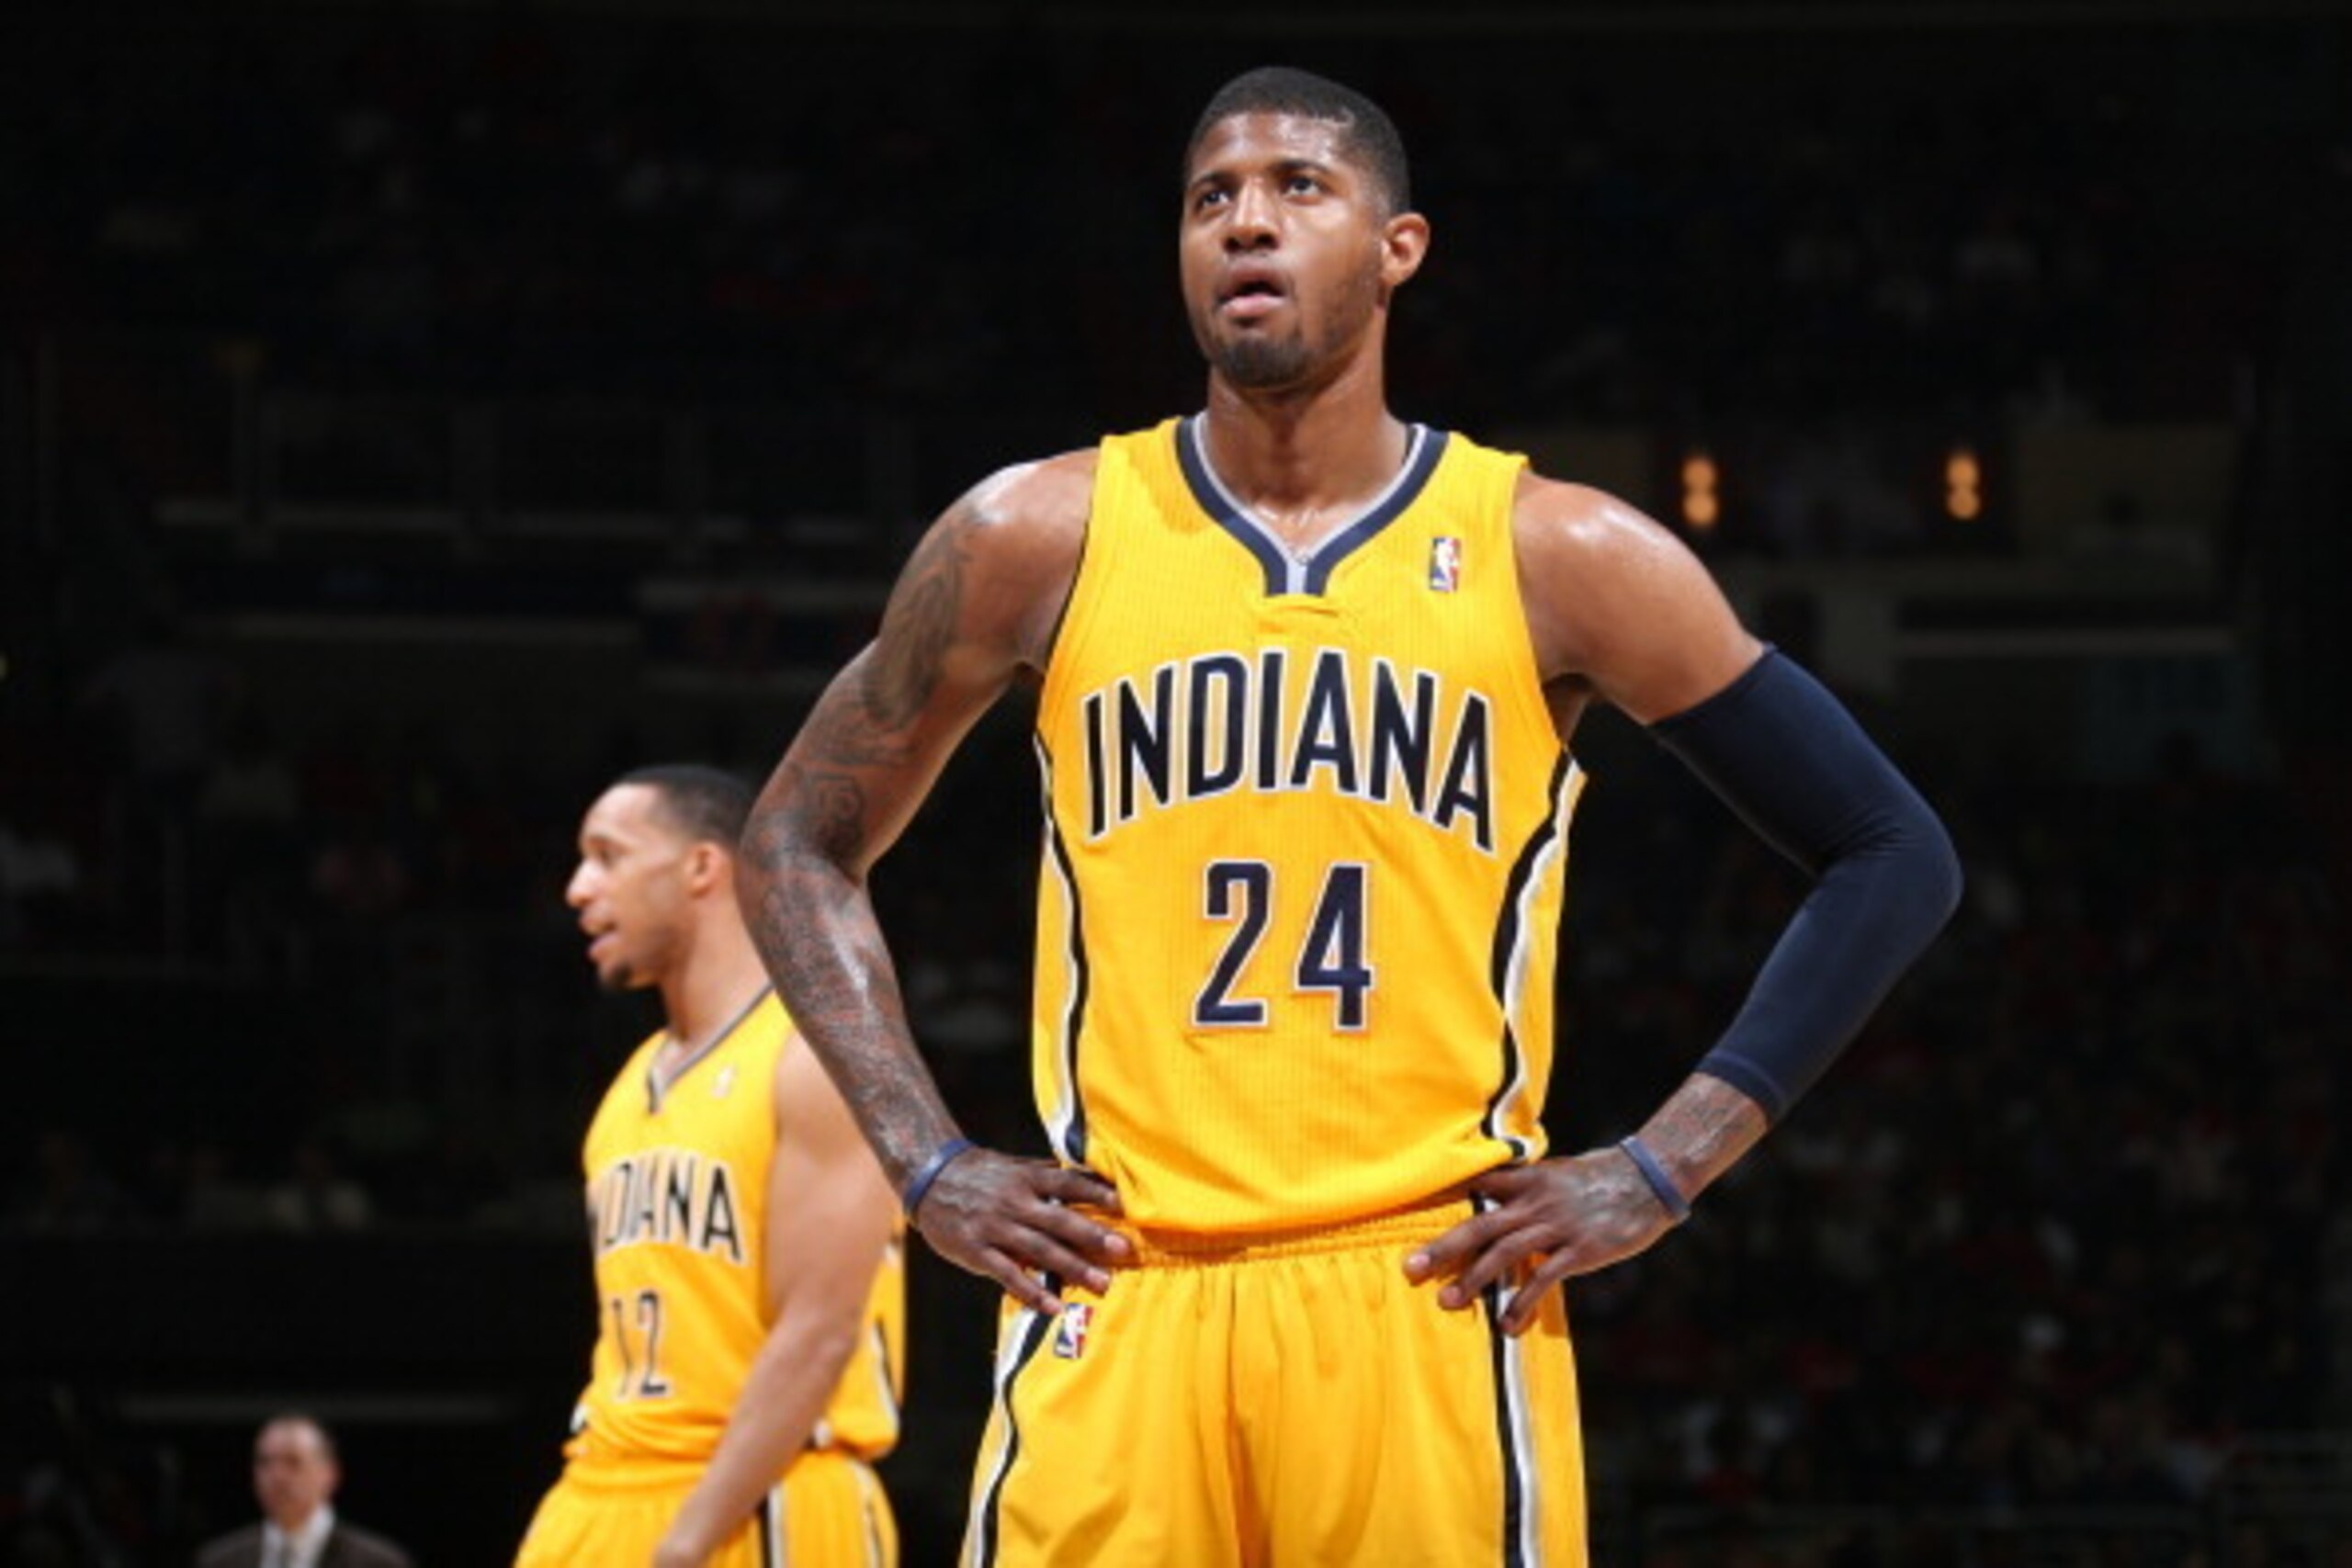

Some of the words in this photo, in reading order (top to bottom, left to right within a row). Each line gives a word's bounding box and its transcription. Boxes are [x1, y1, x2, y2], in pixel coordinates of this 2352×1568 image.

[1082, 646, 1497, 857] INDIANA
[1193, 859, 1374, 1031] 24
[610, 1290, 670, 1400] 12
